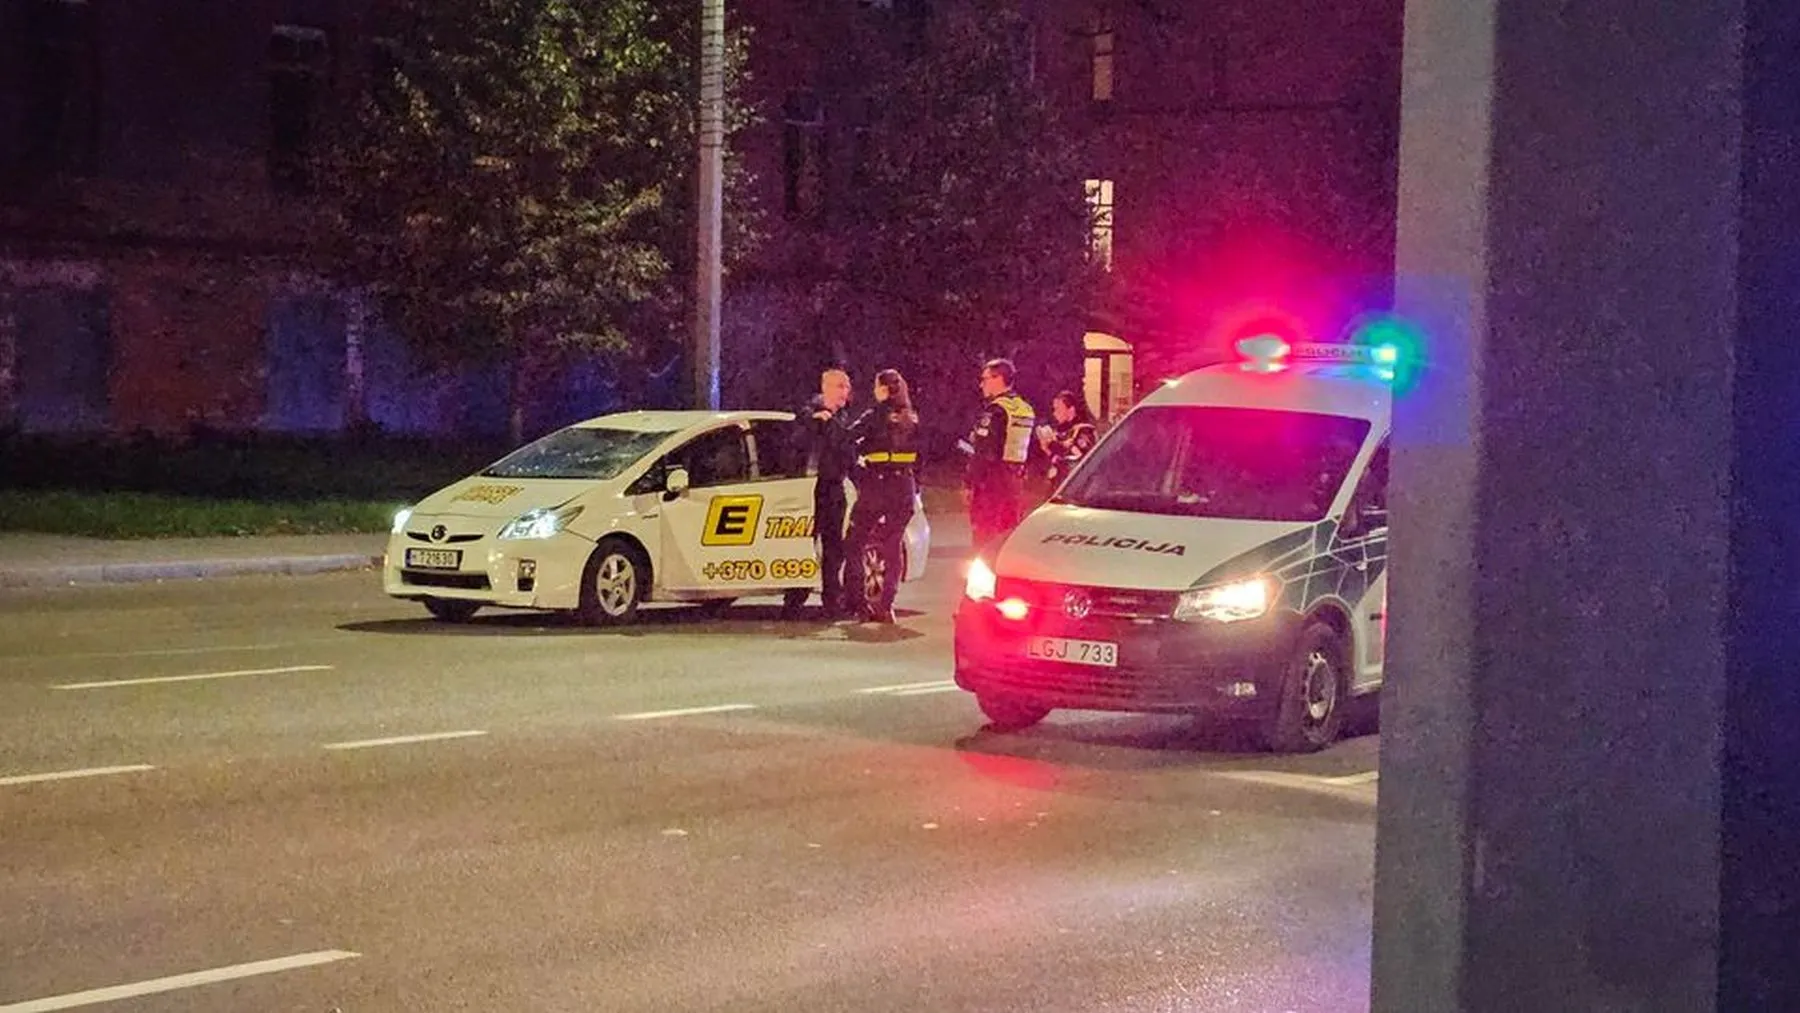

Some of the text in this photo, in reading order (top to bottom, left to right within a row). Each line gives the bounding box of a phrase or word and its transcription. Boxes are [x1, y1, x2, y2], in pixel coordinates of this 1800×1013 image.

[716, 506, 749, 535] E
[1042, 533, 1187, 556] POLICIJA
[703, 558, 818, 580] +370 699
[1029, 640, 1114, 663] LGJ 733
